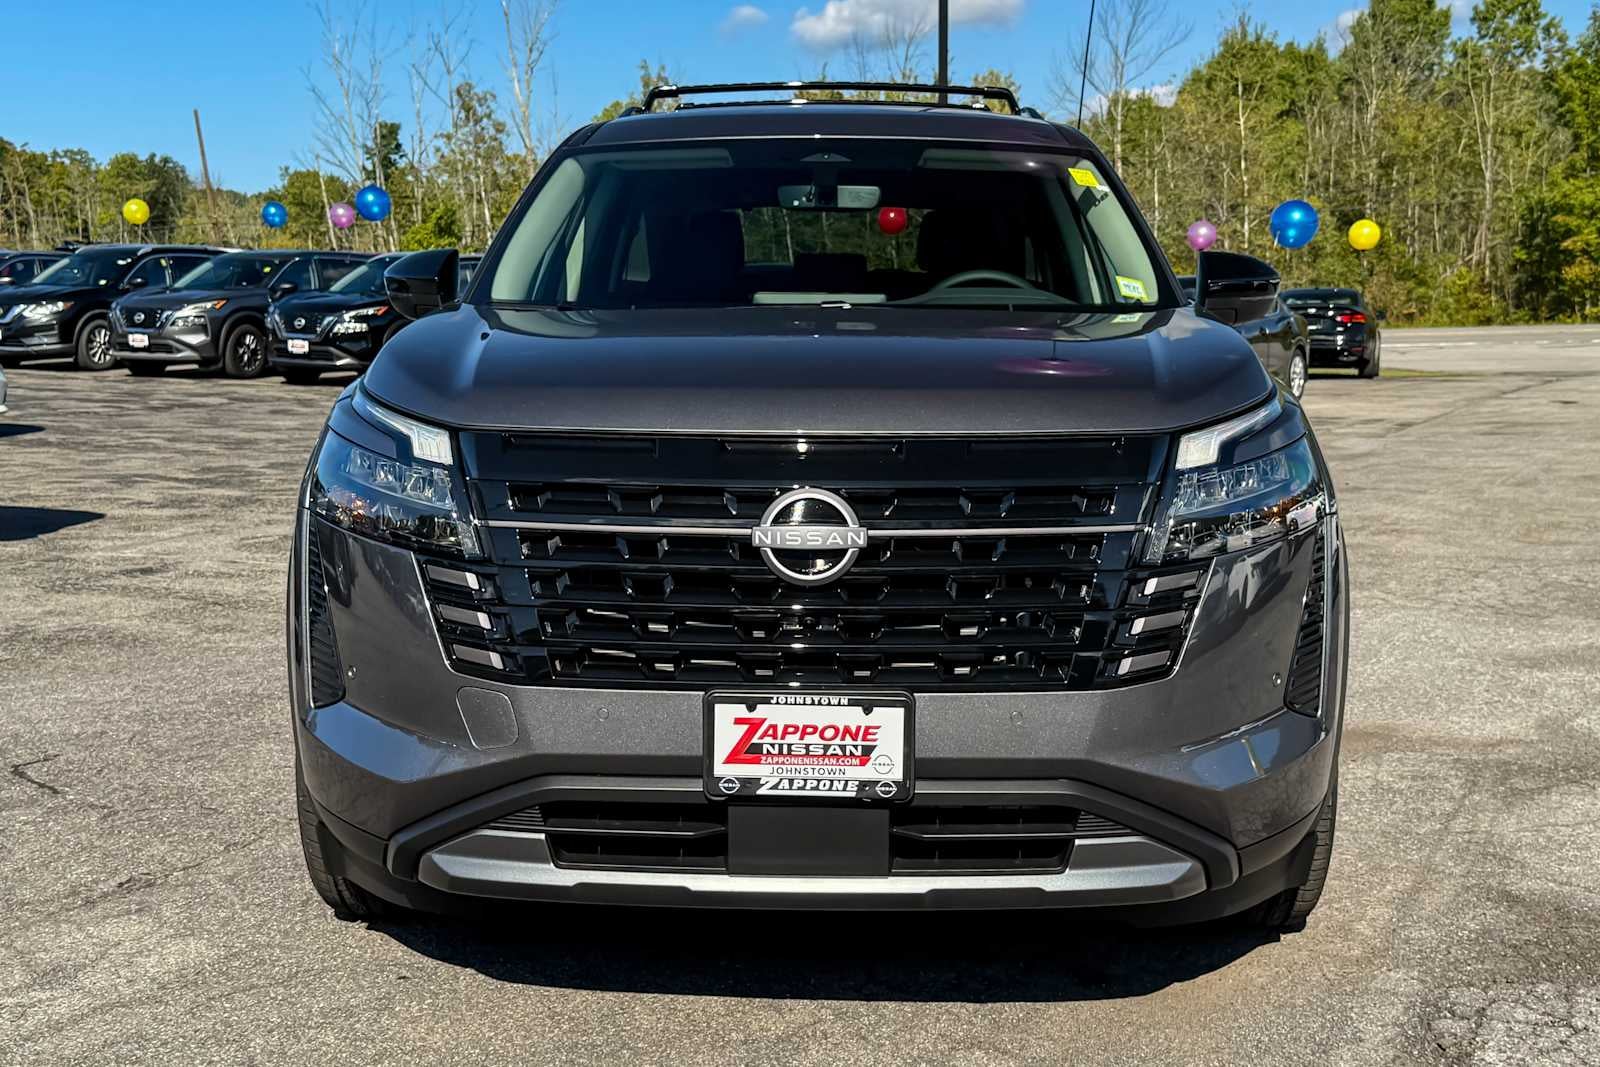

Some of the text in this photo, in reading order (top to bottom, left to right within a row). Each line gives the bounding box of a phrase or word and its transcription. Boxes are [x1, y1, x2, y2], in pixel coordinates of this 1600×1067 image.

[755, 530, 864, 545] NISSAN
[770, 695, 849, 706] JOHNSTOWN
[722, 717, 882, 765] ZAPPONE
[762, 743, 863, 756] NISSAN
[759, 756, 862, 766] ZAPPONENISSAN.COM
[770, 767, 846, 776] JOHNSTOWN
[755, 777, 860, 797] ZAPPONE
